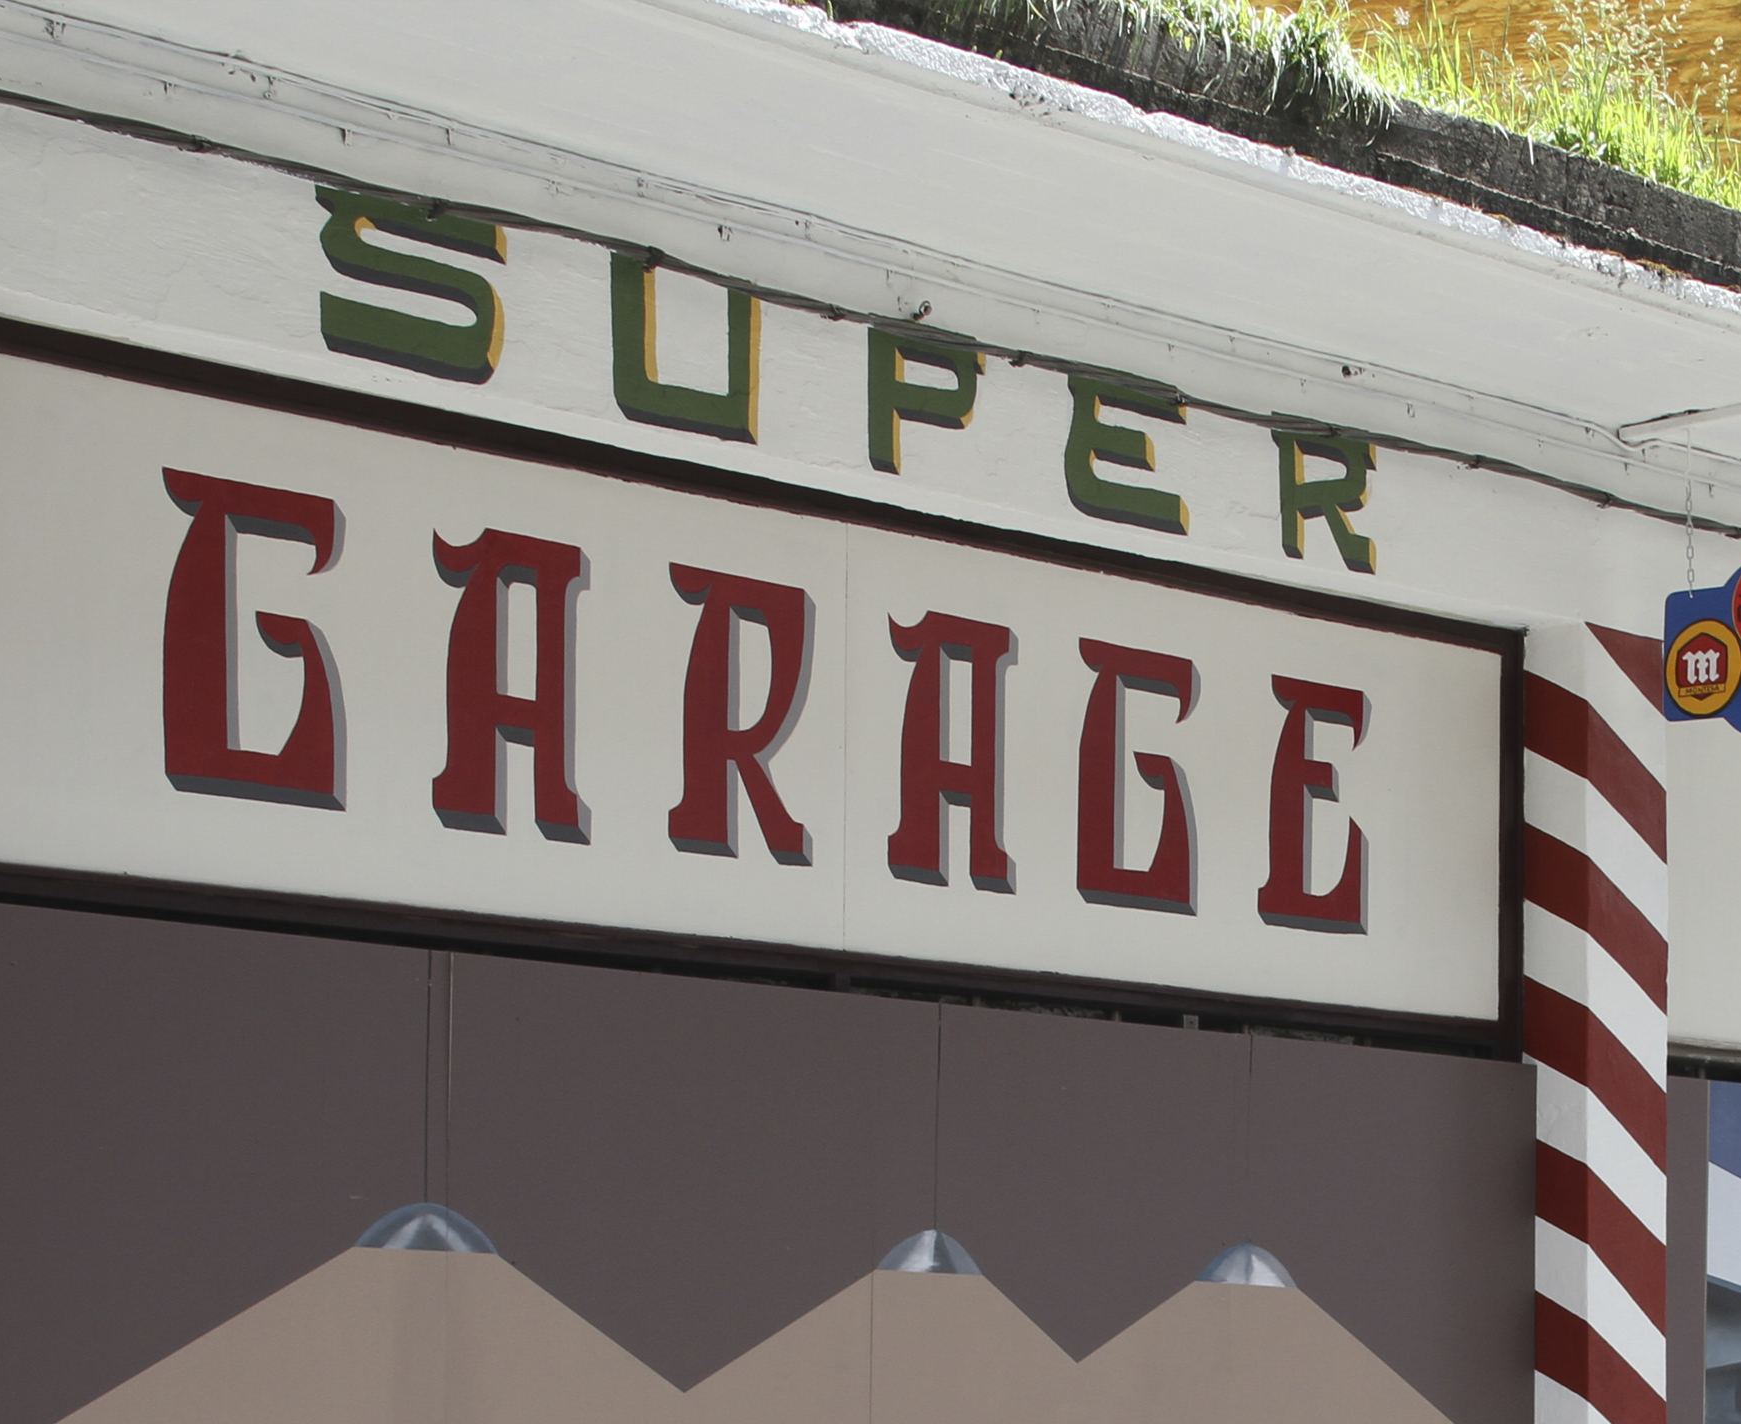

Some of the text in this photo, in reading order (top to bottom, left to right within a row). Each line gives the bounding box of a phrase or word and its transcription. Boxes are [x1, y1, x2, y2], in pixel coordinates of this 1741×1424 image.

[315, 184, 1376, 574] SUPER
[162, 466, 1372, 934] GARAGE
[1685, 684, 1720, 695] MONTESA
